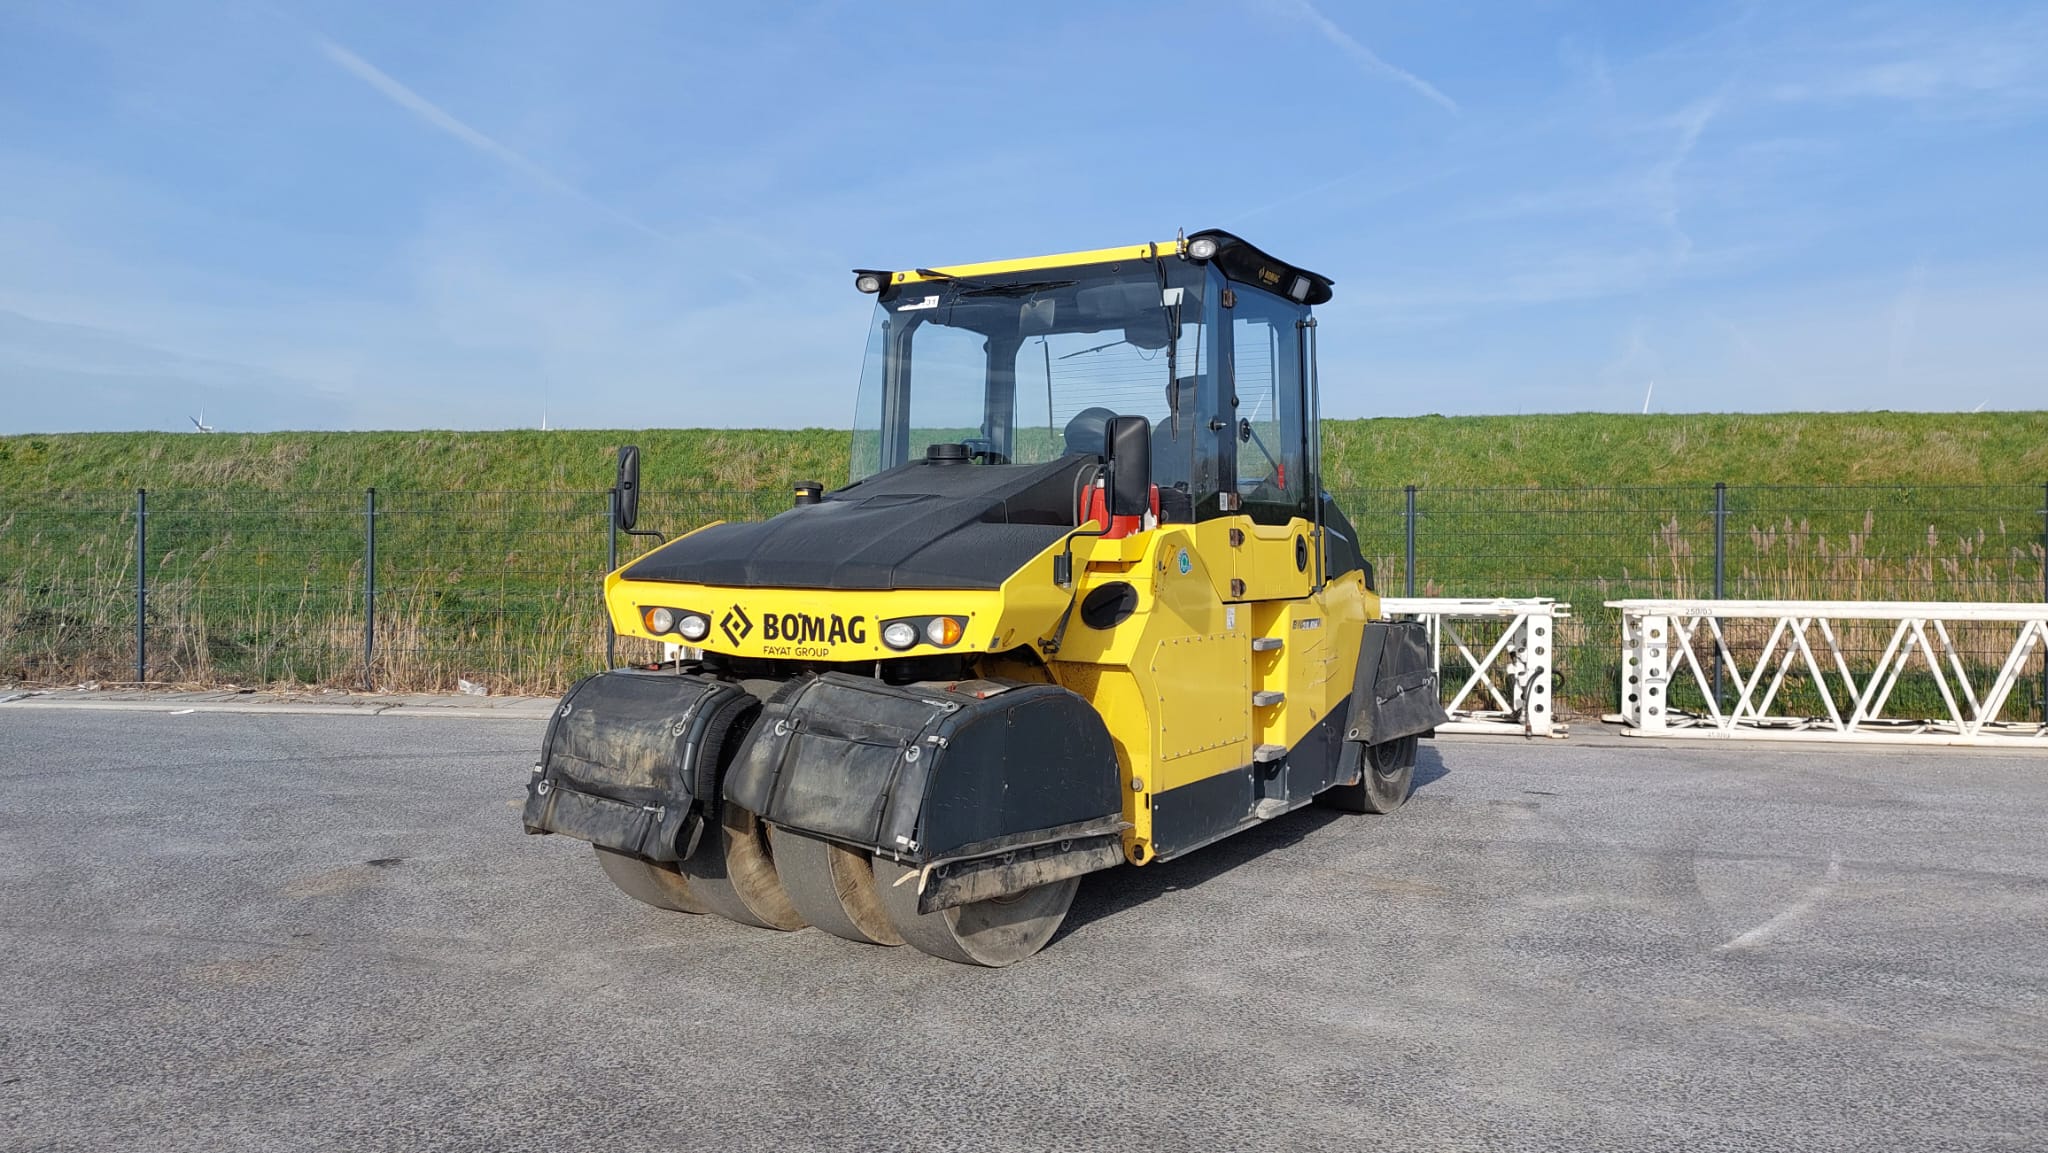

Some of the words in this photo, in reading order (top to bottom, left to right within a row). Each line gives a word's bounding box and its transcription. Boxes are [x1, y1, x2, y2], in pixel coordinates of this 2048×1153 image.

[763, 613, 866, 644] BOMAG
[763, 646, 792, 656] FAYAT
[795, 647, 829, 658] GROUP
